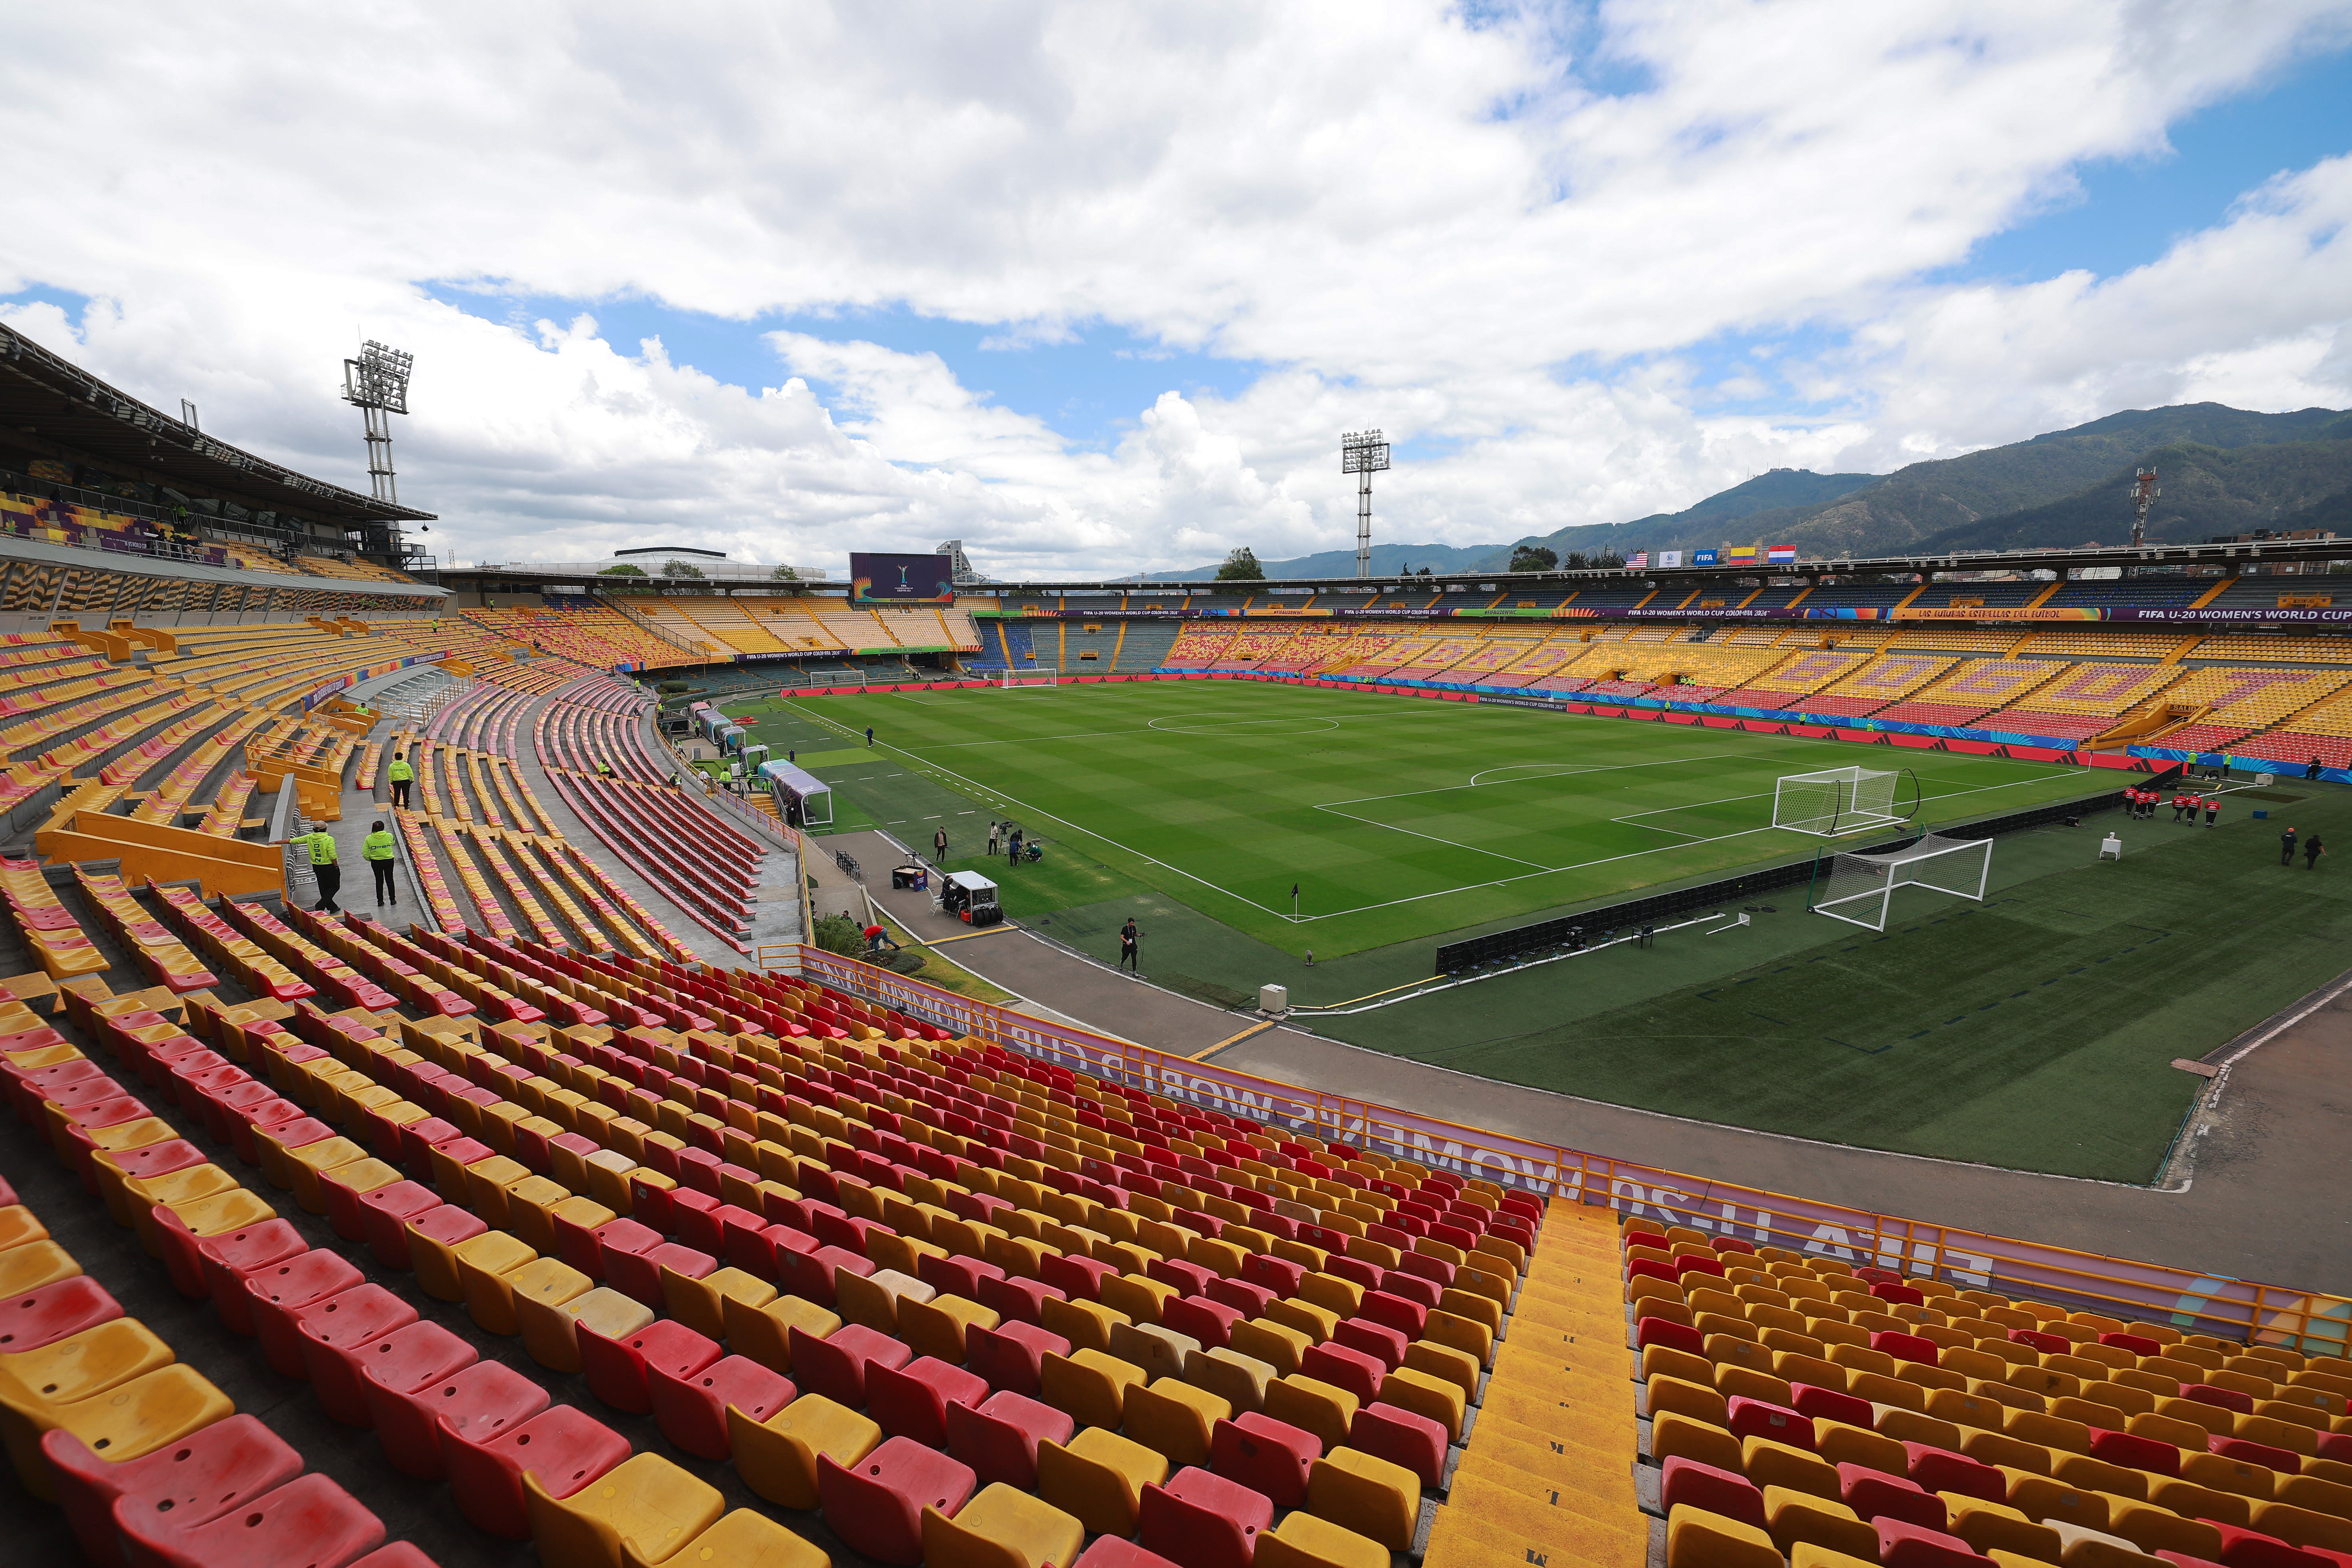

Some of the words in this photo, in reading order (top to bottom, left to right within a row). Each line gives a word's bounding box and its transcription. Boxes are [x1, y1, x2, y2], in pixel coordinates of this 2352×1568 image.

[2199, 611, 2262, 619] WOMEN'S
[2265, 611, 2318, 619] WORLD
[2322, 611, 2352, 620] CUP
[1550, 1441, 1564, 1455] K
[1545, 1488, 1560, 1506] L
